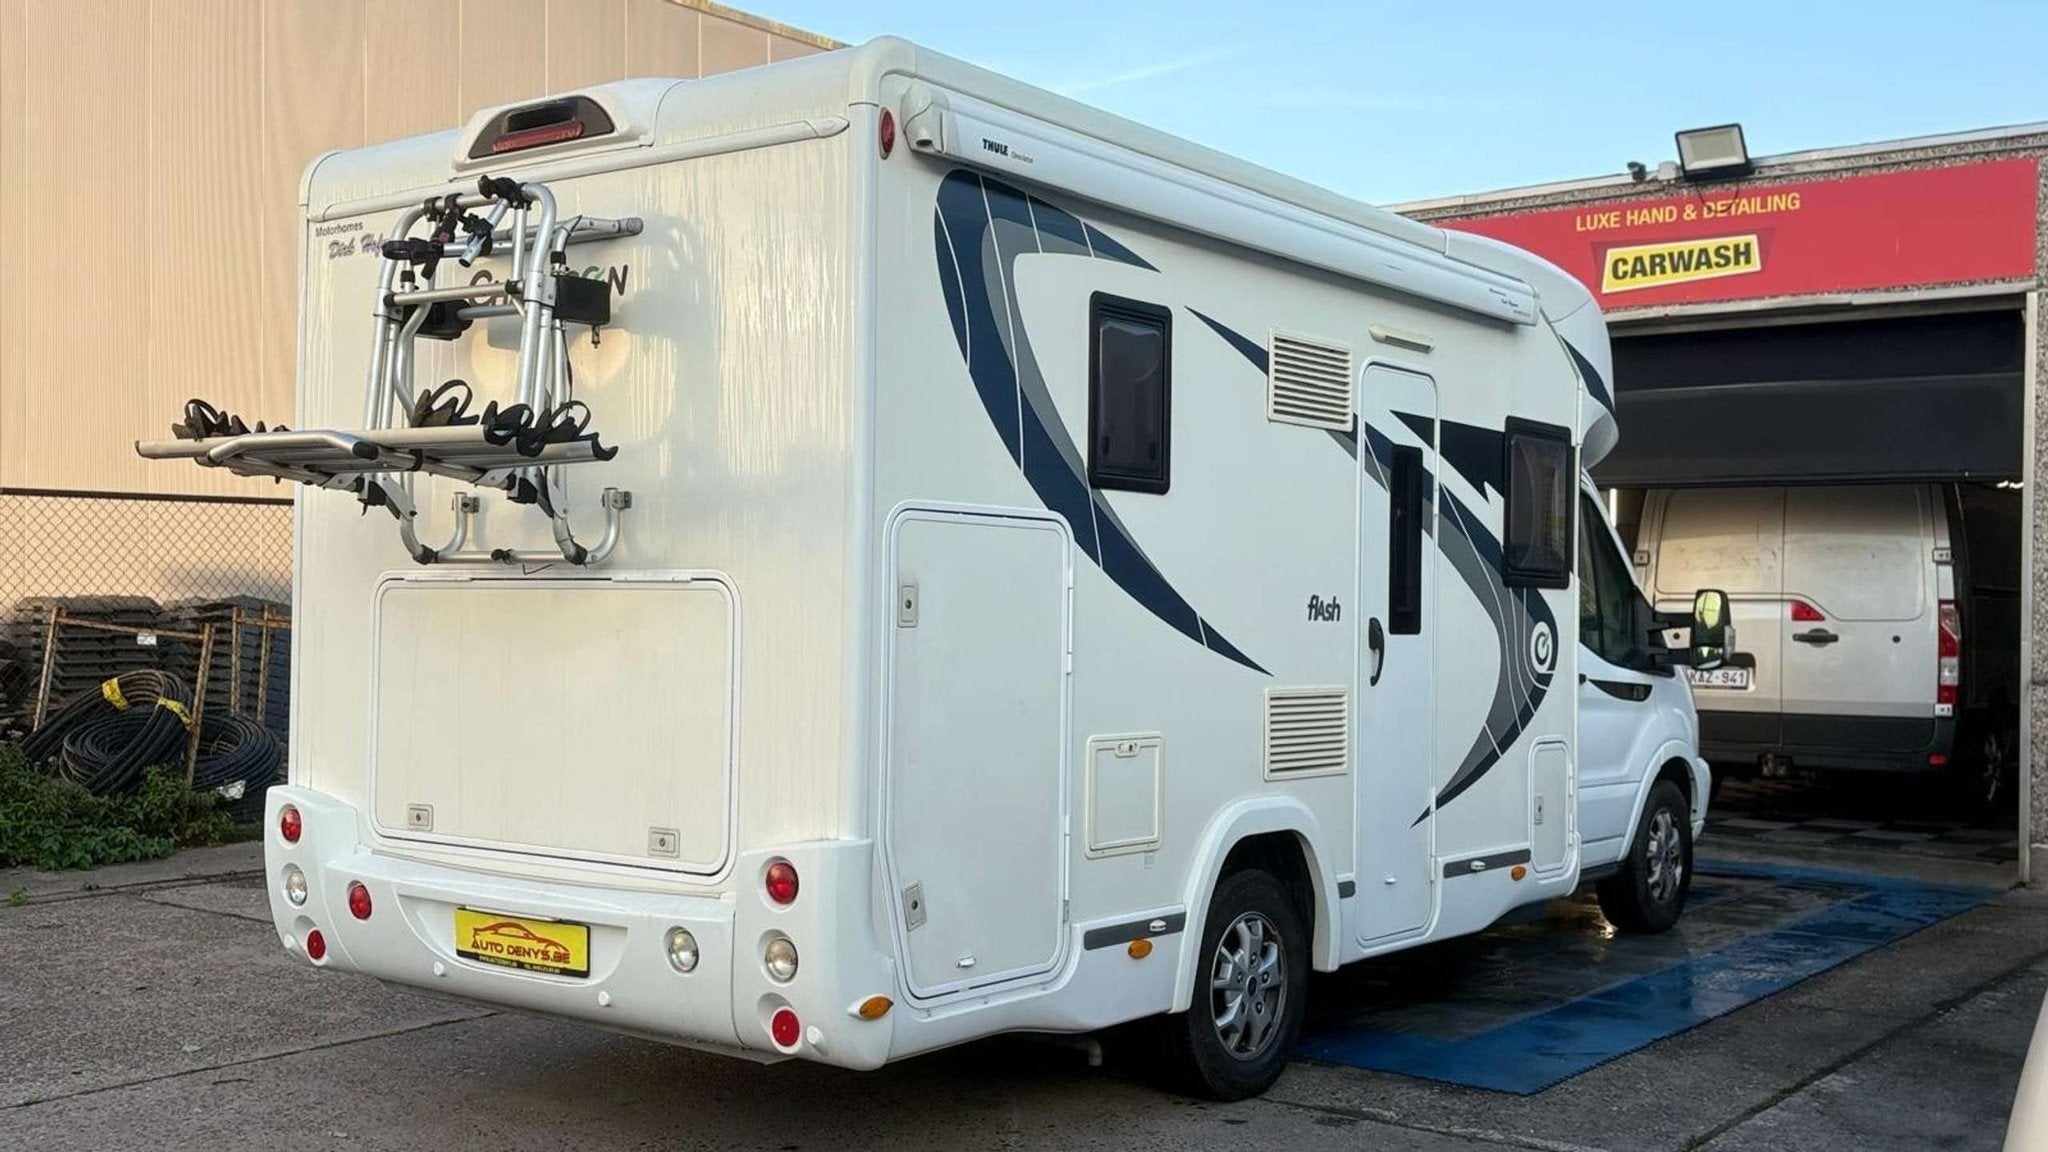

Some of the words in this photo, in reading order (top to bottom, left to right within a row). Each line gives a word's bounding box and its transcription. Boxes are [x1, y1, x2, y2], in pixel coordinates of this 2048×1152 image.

[982, 138, 1008, 156] THULE
[1576, 211, 1621, 232] LUXE
[1626, 205, 1678, 227] HAND
[1683, 203, 1697, 221] &
[1703, 192, 1801, 219] DETAILING
[315, 222, 364, 237] Motorhomes
[1611, 242, 1752, 280] CARWASH
[471, 939, 504, 954] AUTO
